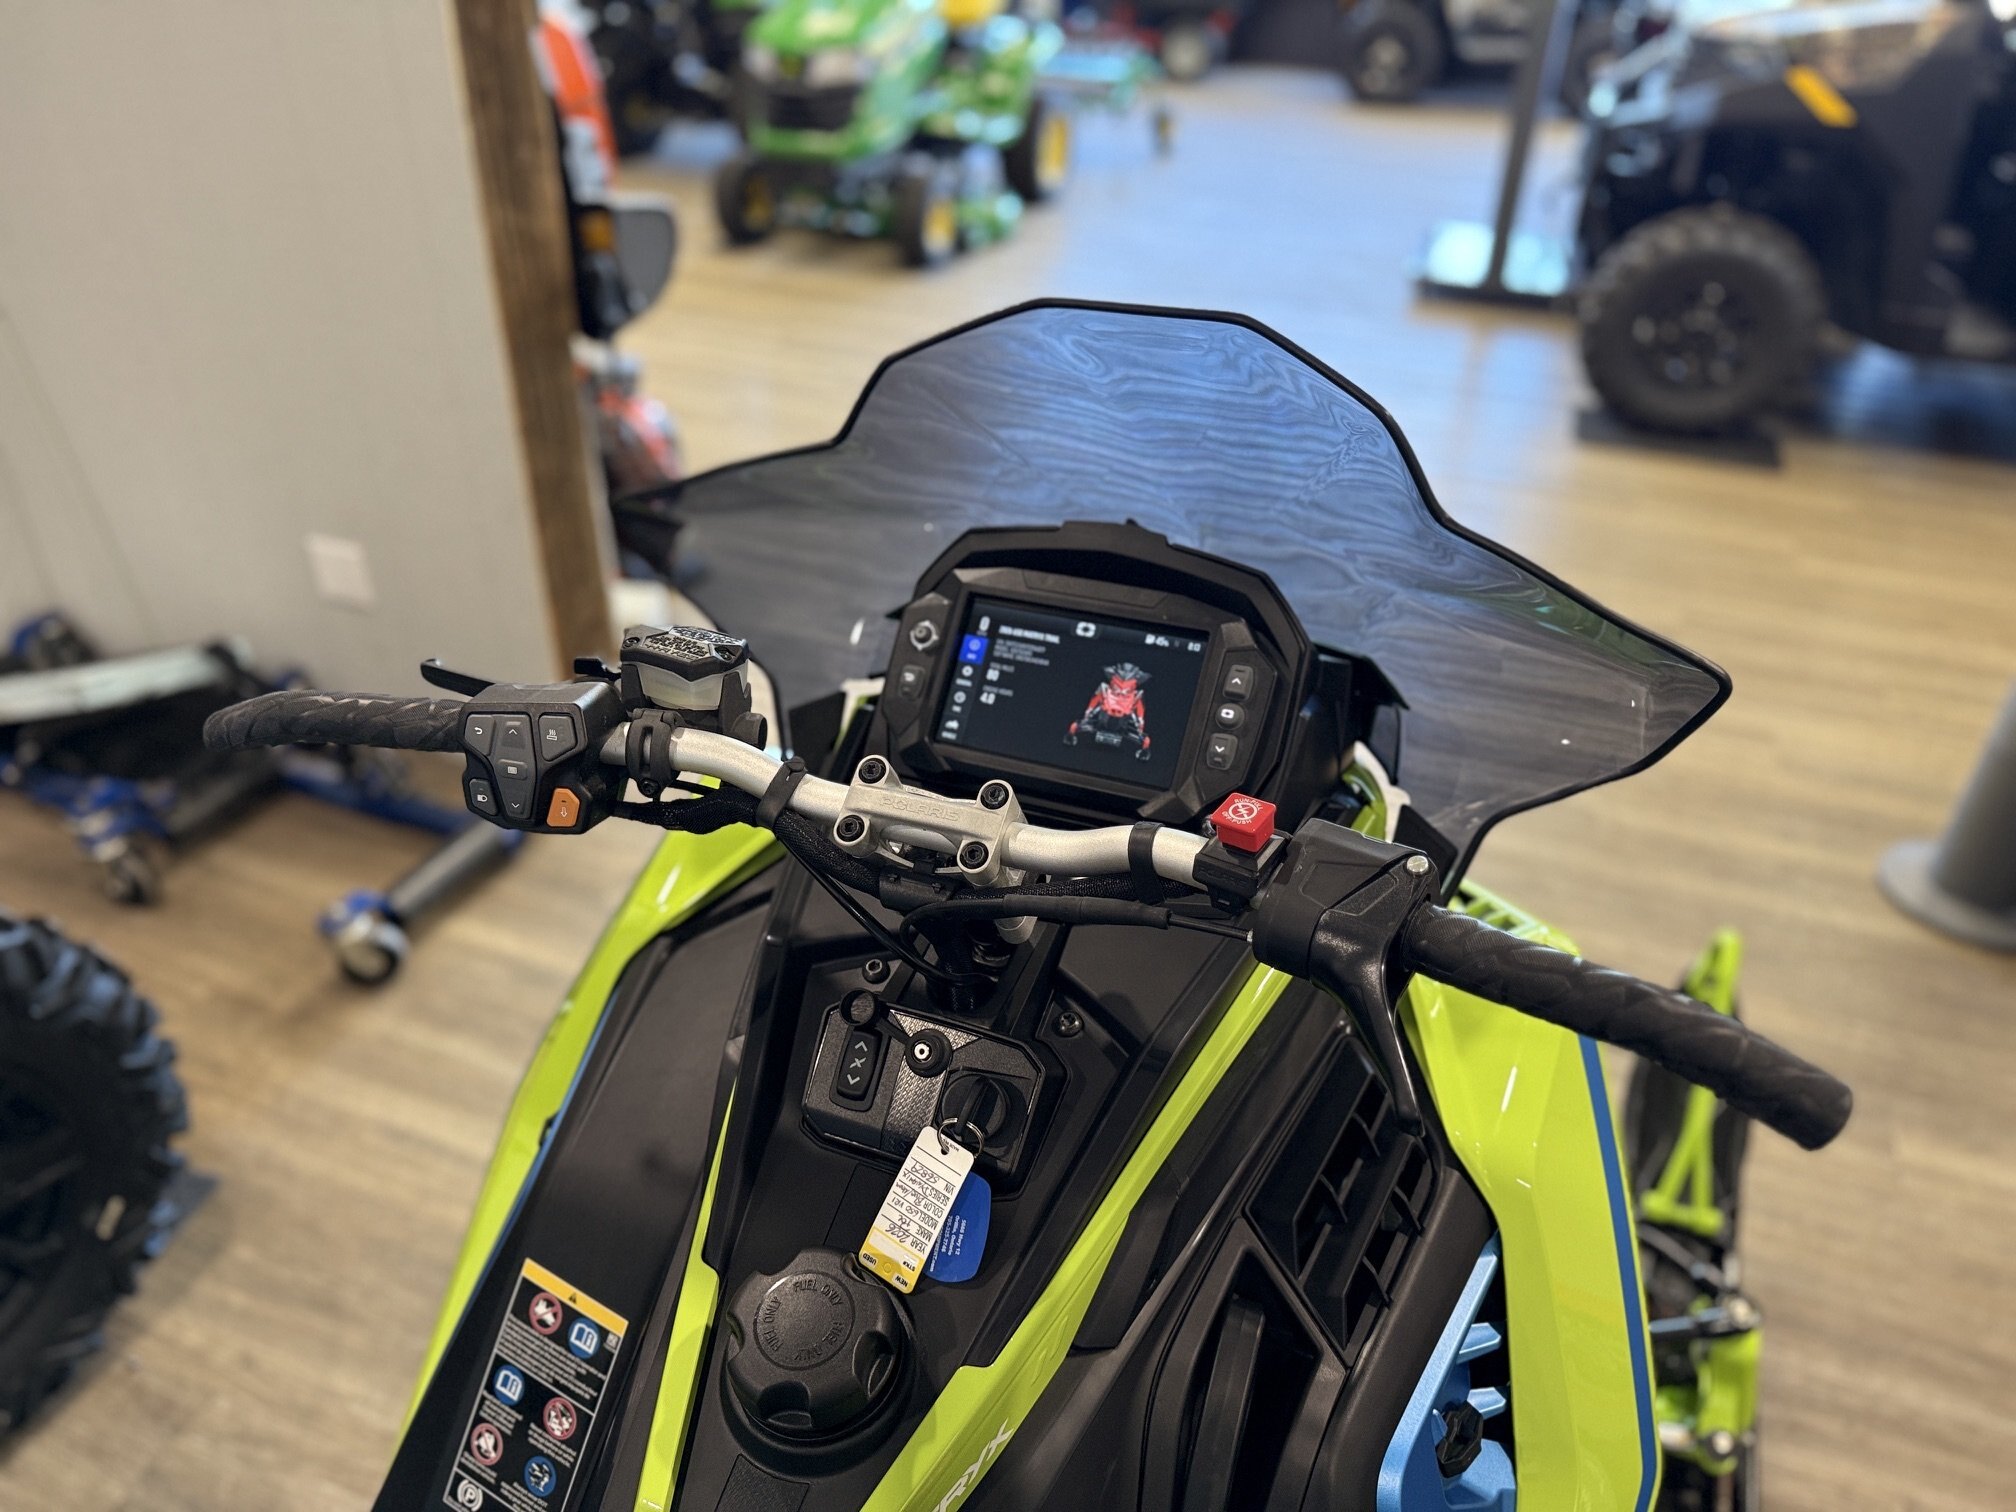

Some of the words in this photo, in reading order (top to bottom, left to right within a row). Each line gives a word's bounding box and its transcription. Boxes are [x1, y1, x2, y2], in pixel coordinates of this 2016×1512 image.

[880, 797, 960, 822] POLARIS
[930, 1187, 950, 1206] SERIES
[944, 1184, 955, 1196] VIN
[923, 1201, 944, 1218] COLOR
[918, 1210, 938, 1230] MODEL
[885, 1224, 910, 1243] 2026
[916, 1228, 933, 1242] MAKE
[910, 1240, 926, 1254] YEAR
[862, 1252, 876, 1266] USED
[895, 1275, 908, 1287] NEW
[794, 1280, 817, 1292] FUEL
[821, 1284, 842, 1306] ONLY
[763, 1296, 782, 1324] ONLY
[764, 1328, 784, 1352] FUEL
[930, 1417, 1014, 1512] RYX
